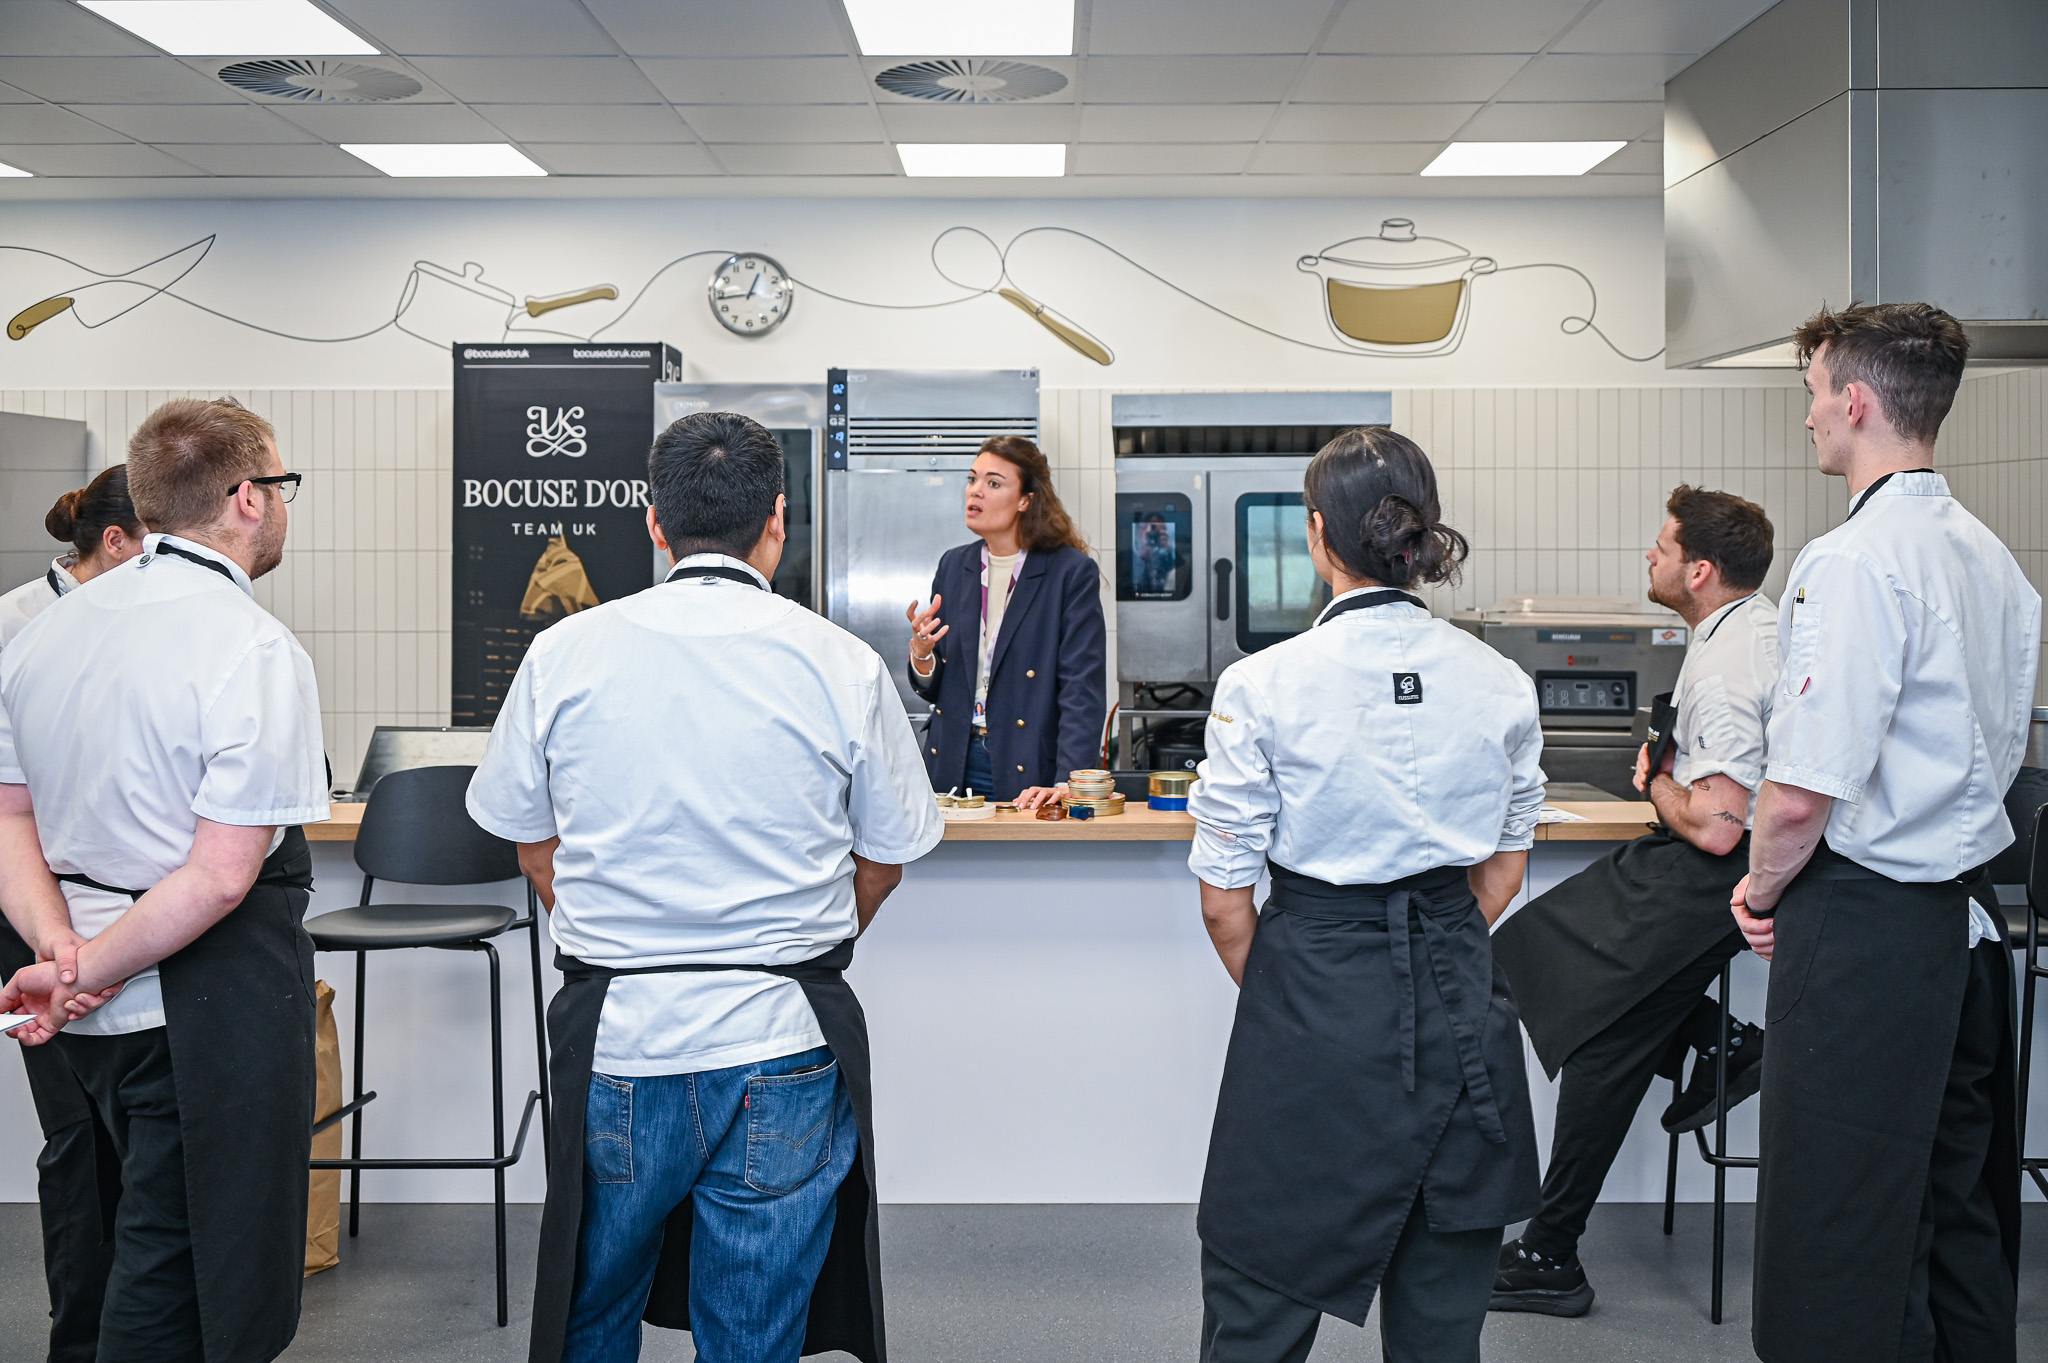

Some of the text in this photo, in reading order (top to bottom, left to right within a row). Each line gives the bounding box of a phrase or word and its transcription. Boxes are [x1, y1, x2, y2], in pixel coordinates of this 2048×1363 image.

[733, 265, 740, 273] 11
[745, 261, 755, 269] 12
[771, 276, 778, 284] 2
[732, 315, 738, 323] 7
[761, 315, 768, 323] 5
[463, 348, 530, 360] @bocusedoruk
[573, 348, 651, 359] bocusedoruk.com
[829, 417, 846, 426] G2
[463, 479, 650, 508] BOCUSE D'OR
[511, 522, 597, 536] TEAM UK
